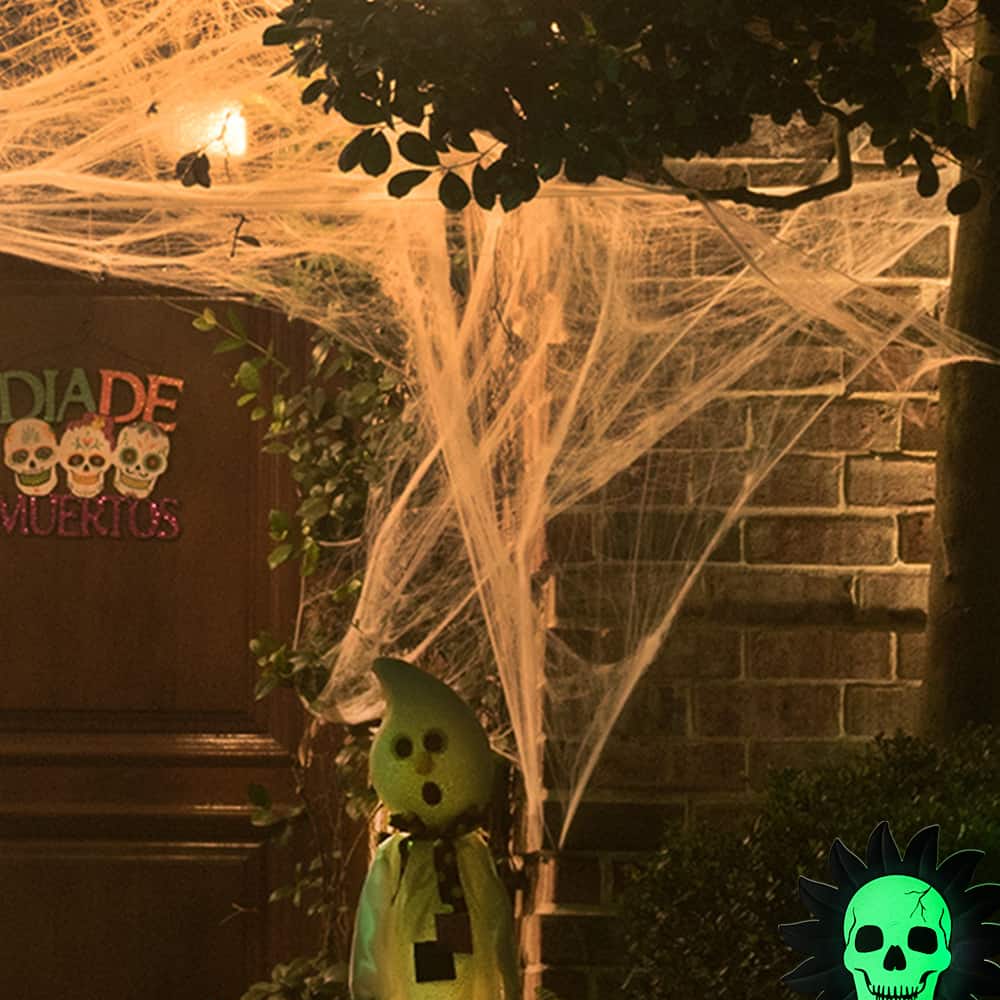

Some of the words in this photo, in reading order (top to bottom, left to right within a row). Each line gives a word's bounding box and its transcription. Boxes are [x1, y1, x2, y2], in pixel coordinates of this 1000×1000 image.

[0, 368, 97, 423] DIA
[99, 369, 184, 431] DE
[0, 495, 181, 537] MUERTOS
